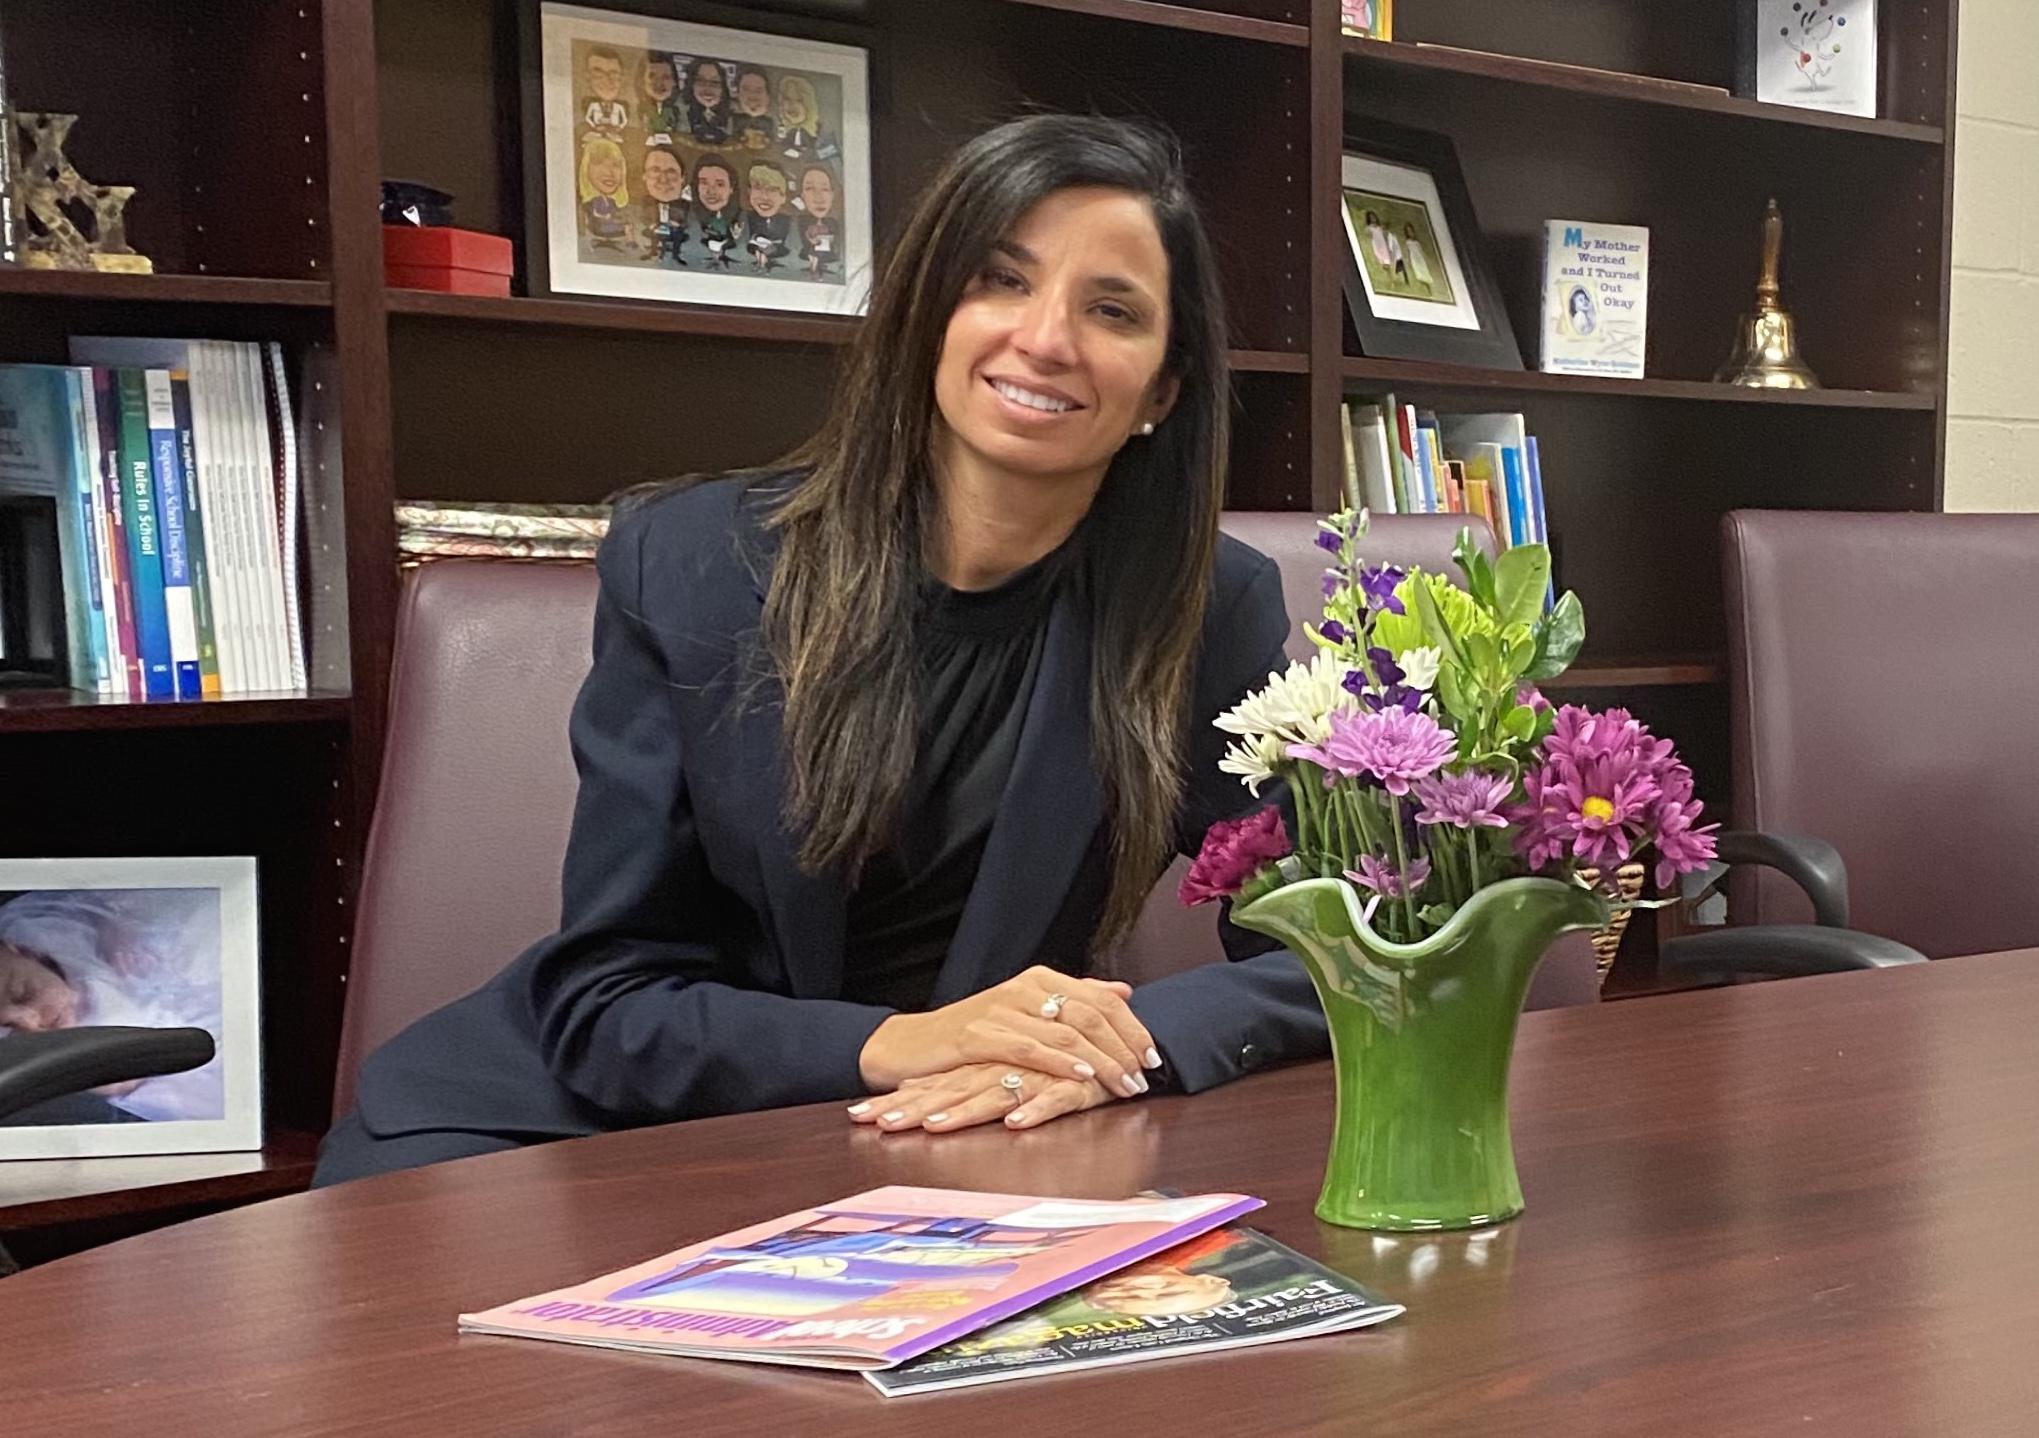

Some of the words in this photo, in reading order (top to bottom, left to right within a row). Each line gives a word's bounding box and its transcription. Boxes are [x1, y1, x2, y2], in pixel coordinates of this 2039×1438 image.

[1563, 227, 1592, 250] My
[1594, 239, 1641, 252] Mother
[1578, 252, 1626, 265] Worked
[1561, 267, 1584, 277] and
[1587, 267, 1593, 277] I
[1595, 268, 1641, 280] Turned
[1600, 282, 1623, 293] Out
[1603, 297, 1634, 310] Okay
[132, 461, 147, 496] Rules
[165, 496, 182, 529] School
[139, 515, 156, 556] School
[167, 529, 184, 579] Discipline
[1144, 1279, 1344, 1328] Fairfield
[511, 1301, 791, 1338] Administrator
[759, 1316, 930, 1341] School
